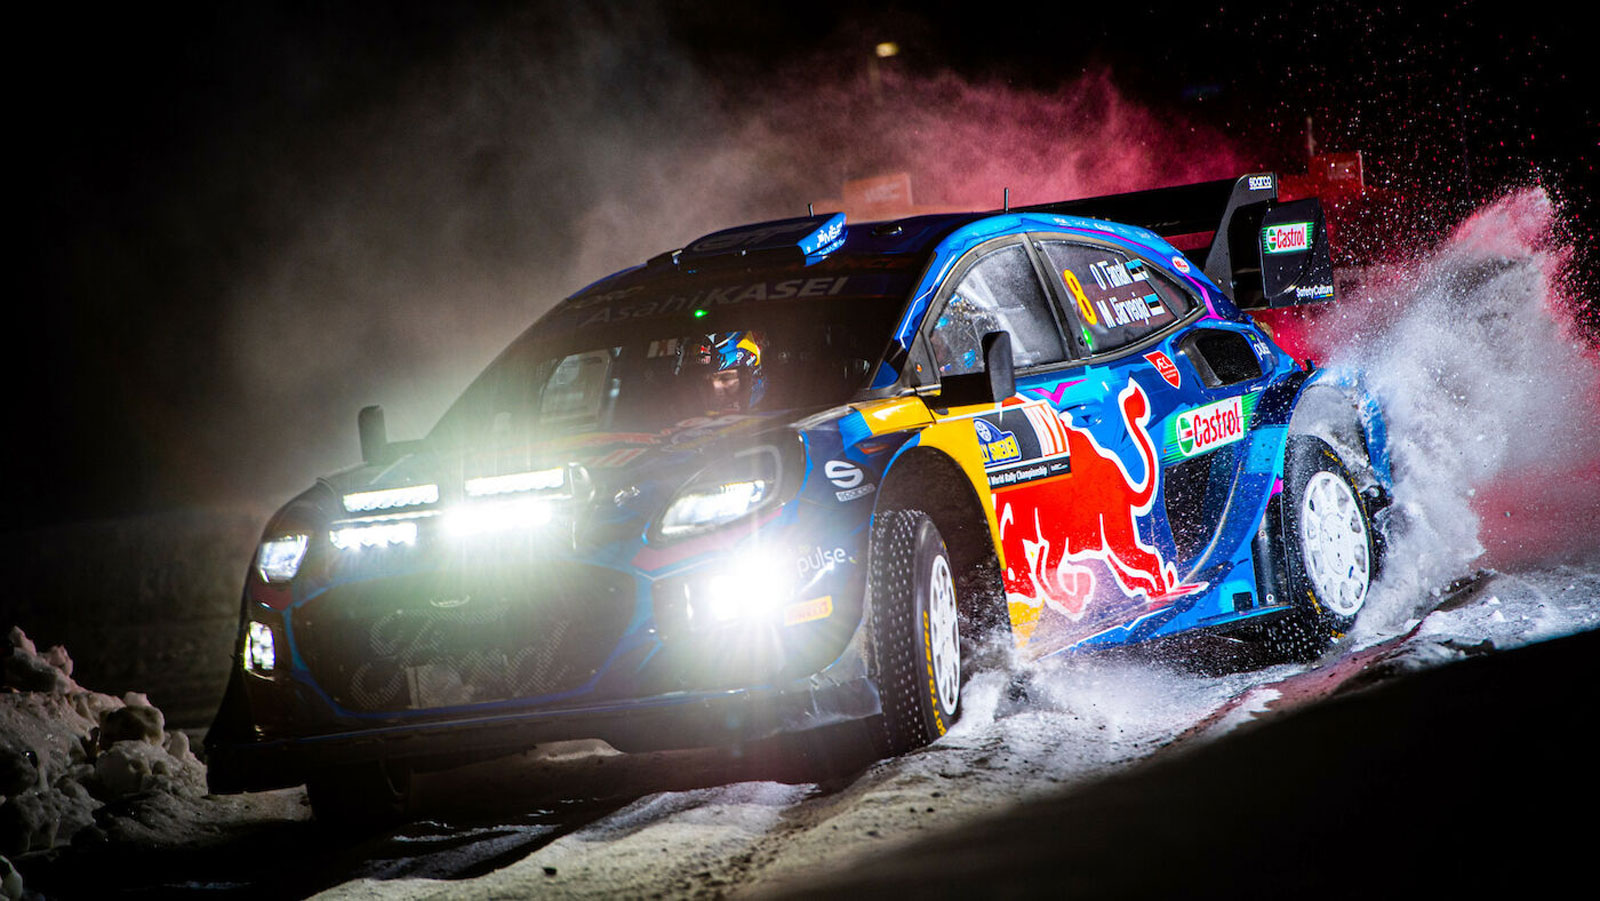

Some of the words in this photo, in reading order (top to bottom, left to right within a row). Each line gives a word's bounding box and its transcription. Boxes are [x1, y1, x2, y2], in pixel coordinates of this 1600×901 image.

[1277, 227, 1305, 249] Castrol
[1089, 264, 1107, 290] O
[1063, 269, 1098, 325] 8
[1295, 284, 1334, 299] SafetyCulture
[1096, 300, 1117, 328] M
[1193, 402, 1242, 448] Castrol
[988, 435, 1020, 461] SWEDEN
[990, 474, 1005, 485] World
[1005, 472, 1017, 483] Rally
[1016, 465, 1048, 480] Championship
[797, 546, 847, 577] pulse
